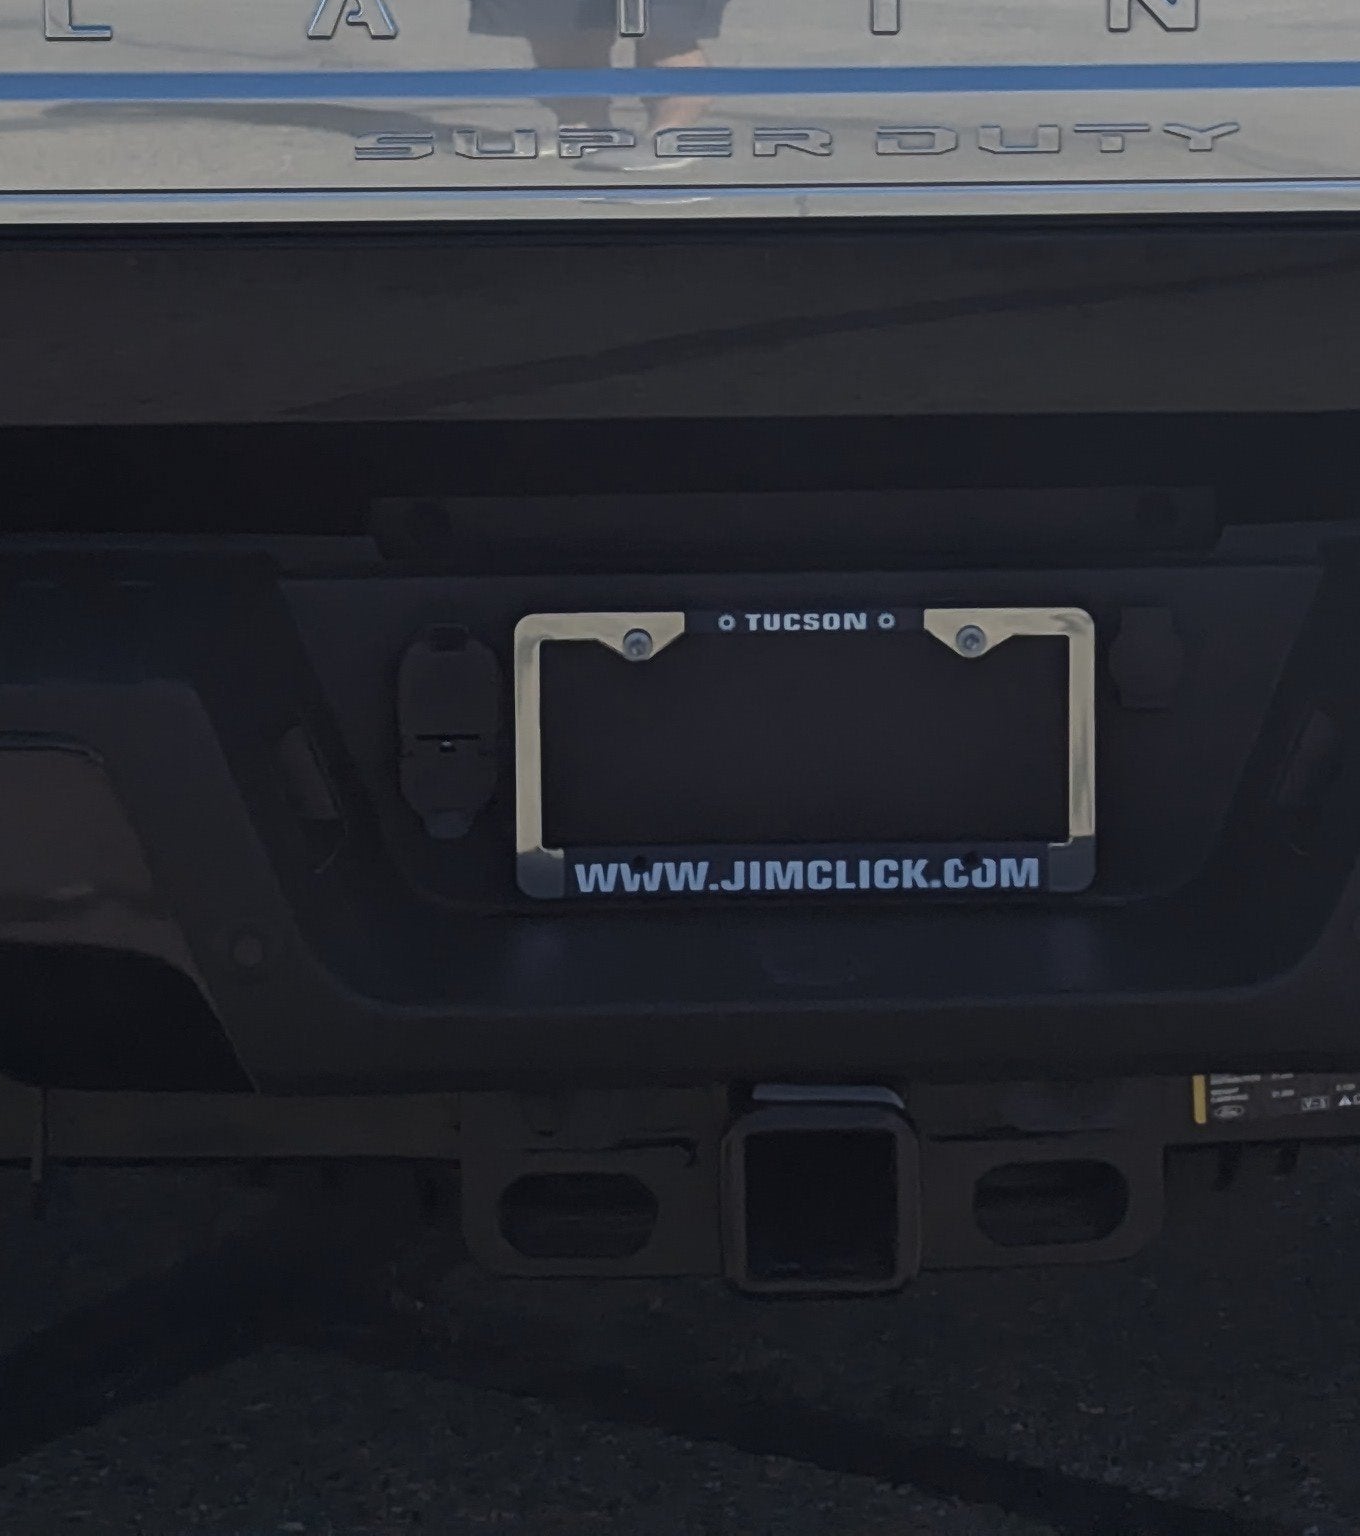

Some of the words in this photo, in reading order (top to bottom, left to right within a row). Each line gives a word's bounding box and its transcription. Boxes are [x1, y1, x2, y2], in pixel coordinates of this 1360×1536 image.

[353, 125, 834, 162] SUPER
[874, 121, 1241, 157] DUTY
[745, 612, 868, 632] TUCSON
[574, 857, 1039, 893] WWW.JIMCLICK.COM
